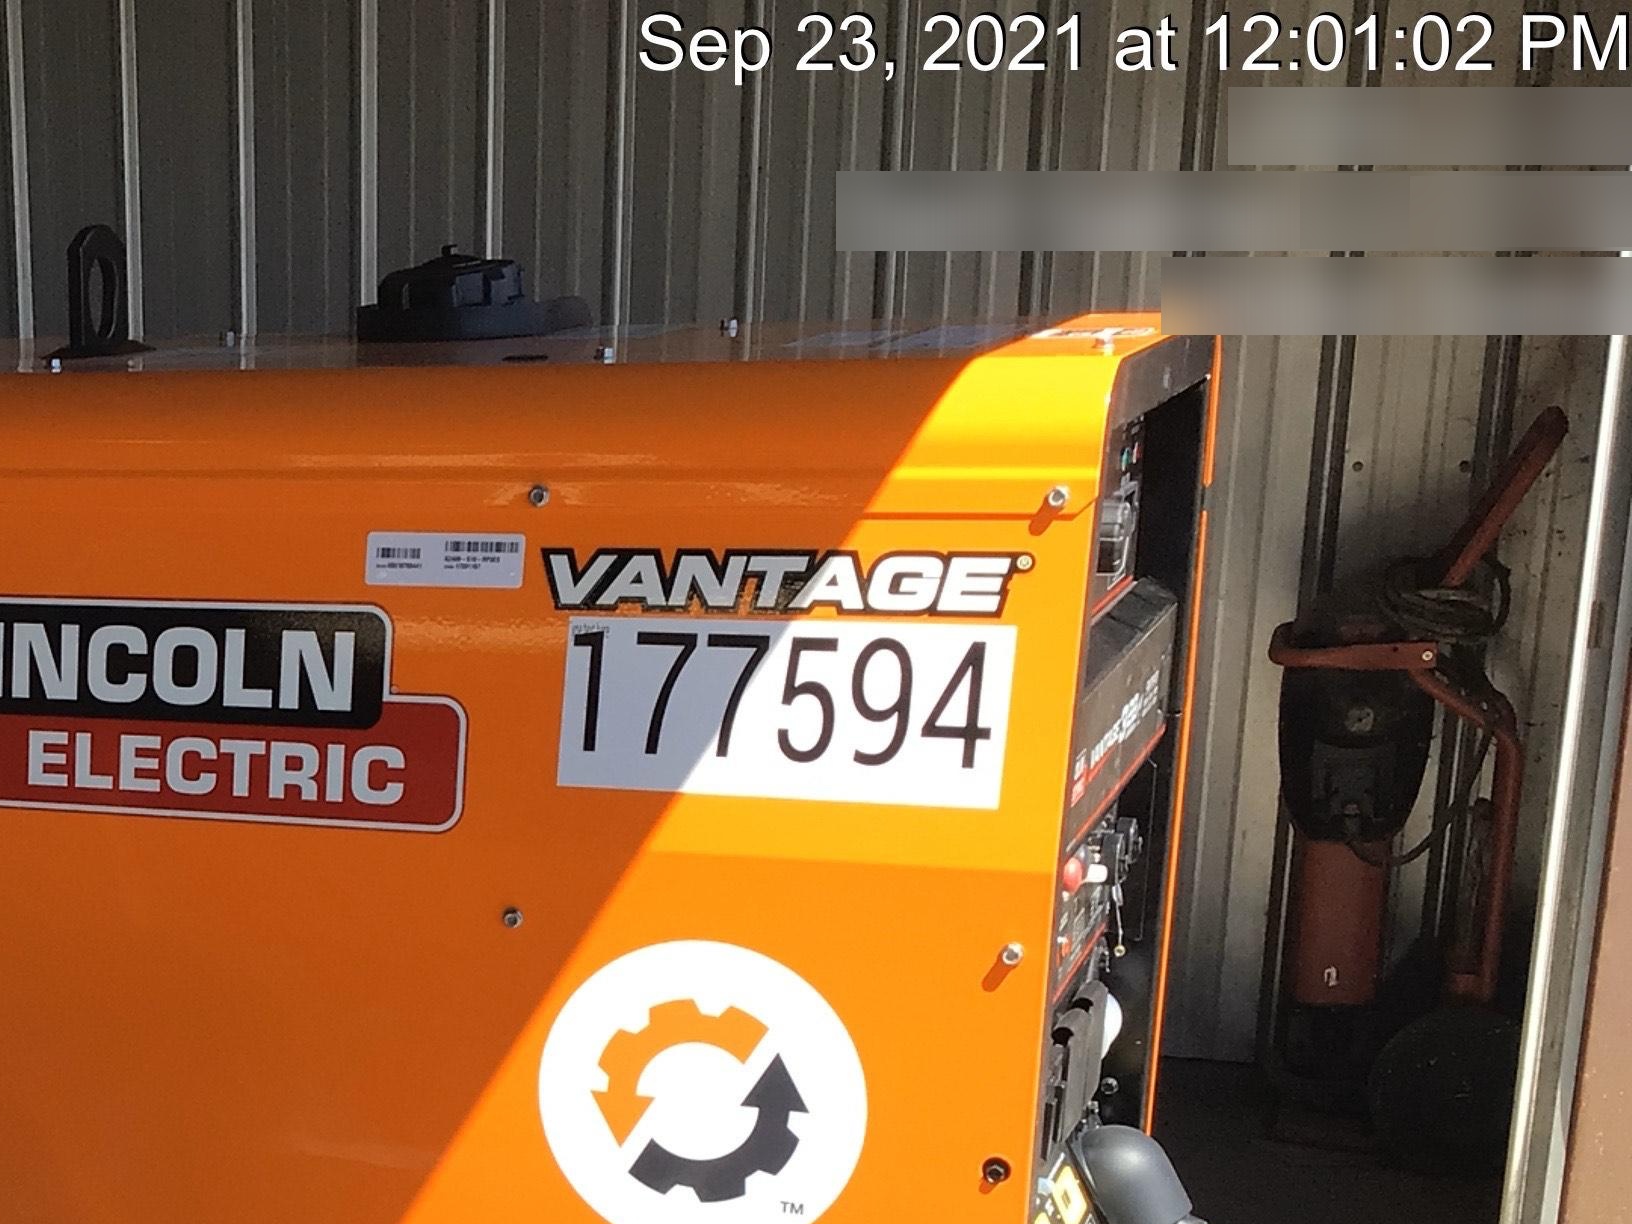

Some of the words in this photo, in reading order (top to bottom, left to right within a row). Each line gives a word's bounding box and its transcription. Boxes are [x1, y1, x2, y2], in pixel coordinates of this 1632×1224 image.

[543, 551, 1013, 615] VANTAGE
[571, 630, 993, 770] 177594
[25, 729, 406, 807] ELECTRIC
